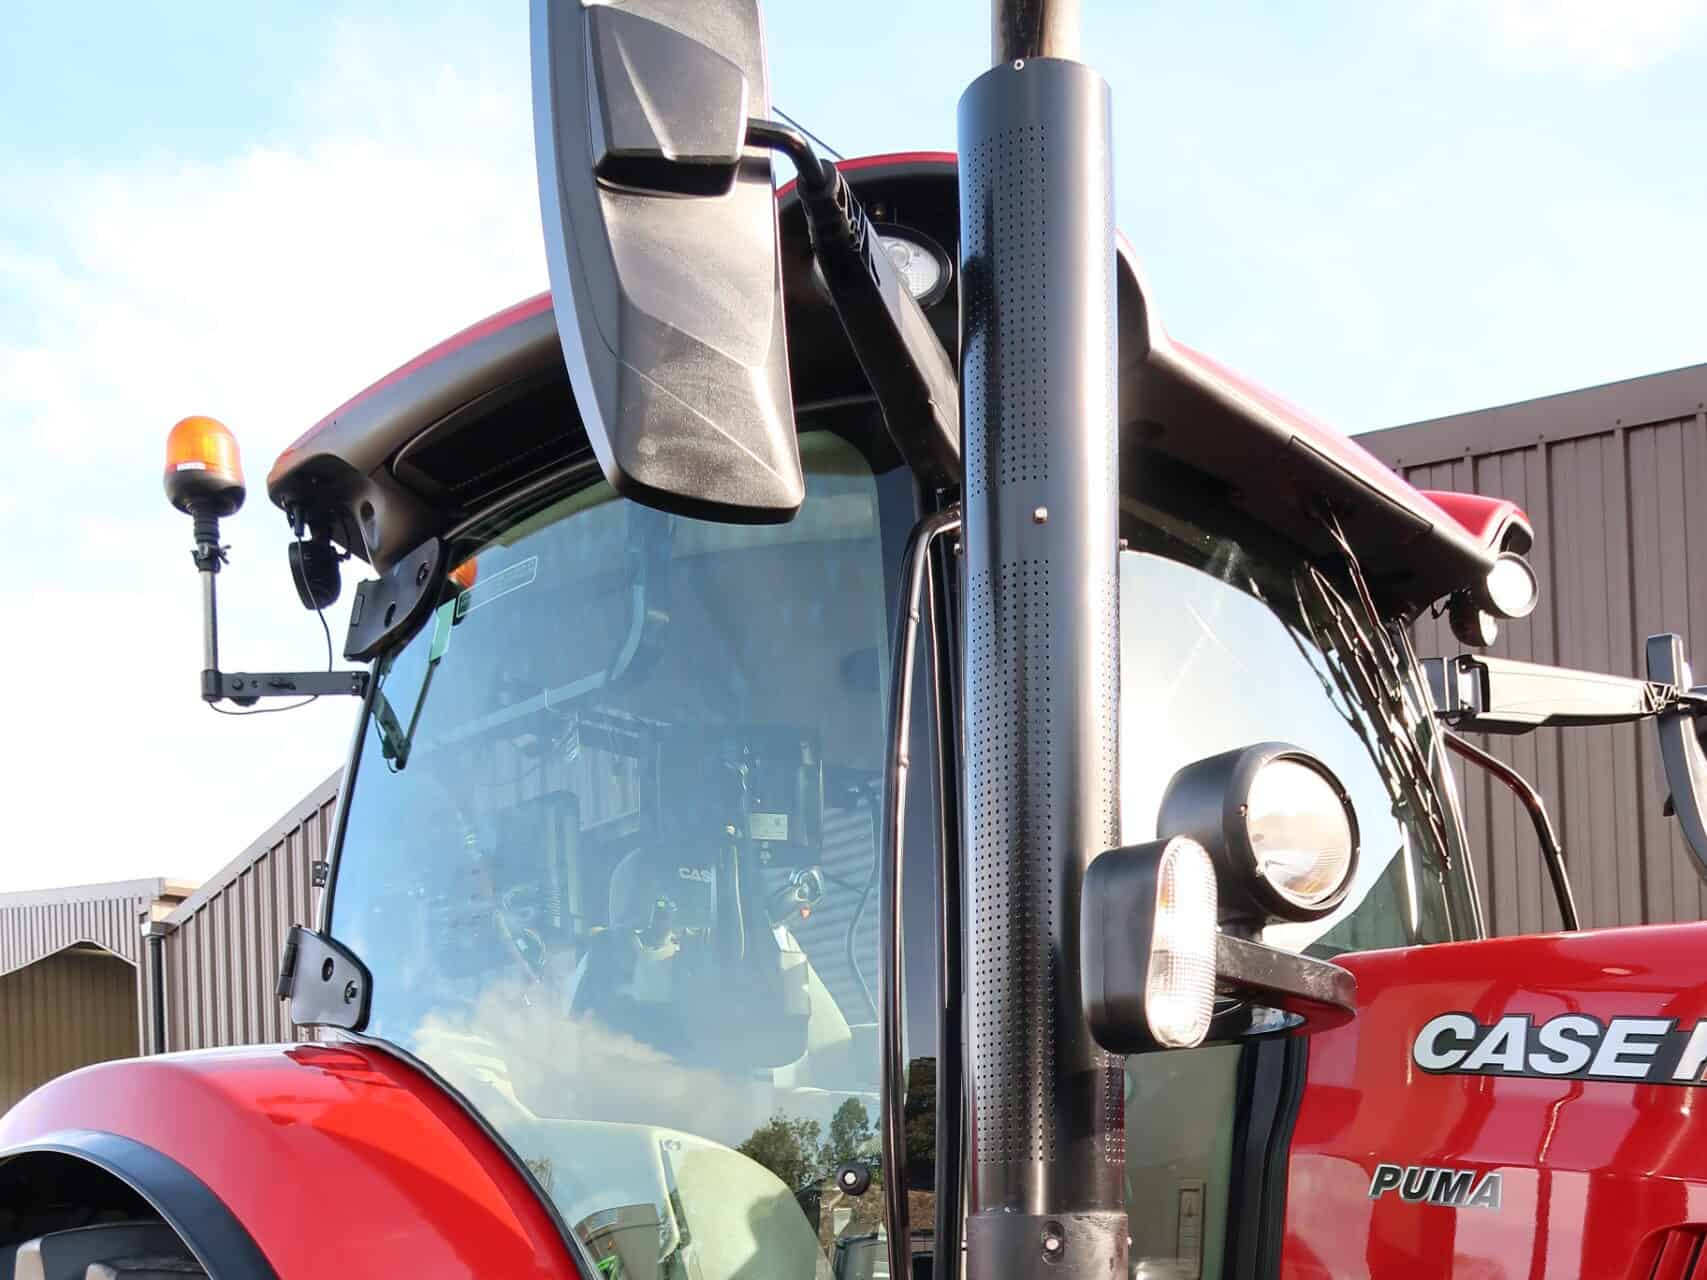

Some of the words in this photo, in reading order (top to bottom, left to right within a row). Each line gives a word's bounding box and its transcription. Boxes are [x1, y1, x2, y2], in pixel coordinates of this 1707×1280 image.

[679, 867, 713, 882] CAS
[1412, 1012, 1674, 1079] CASE
[1368, 1163, 1503, 1209] PUMA
